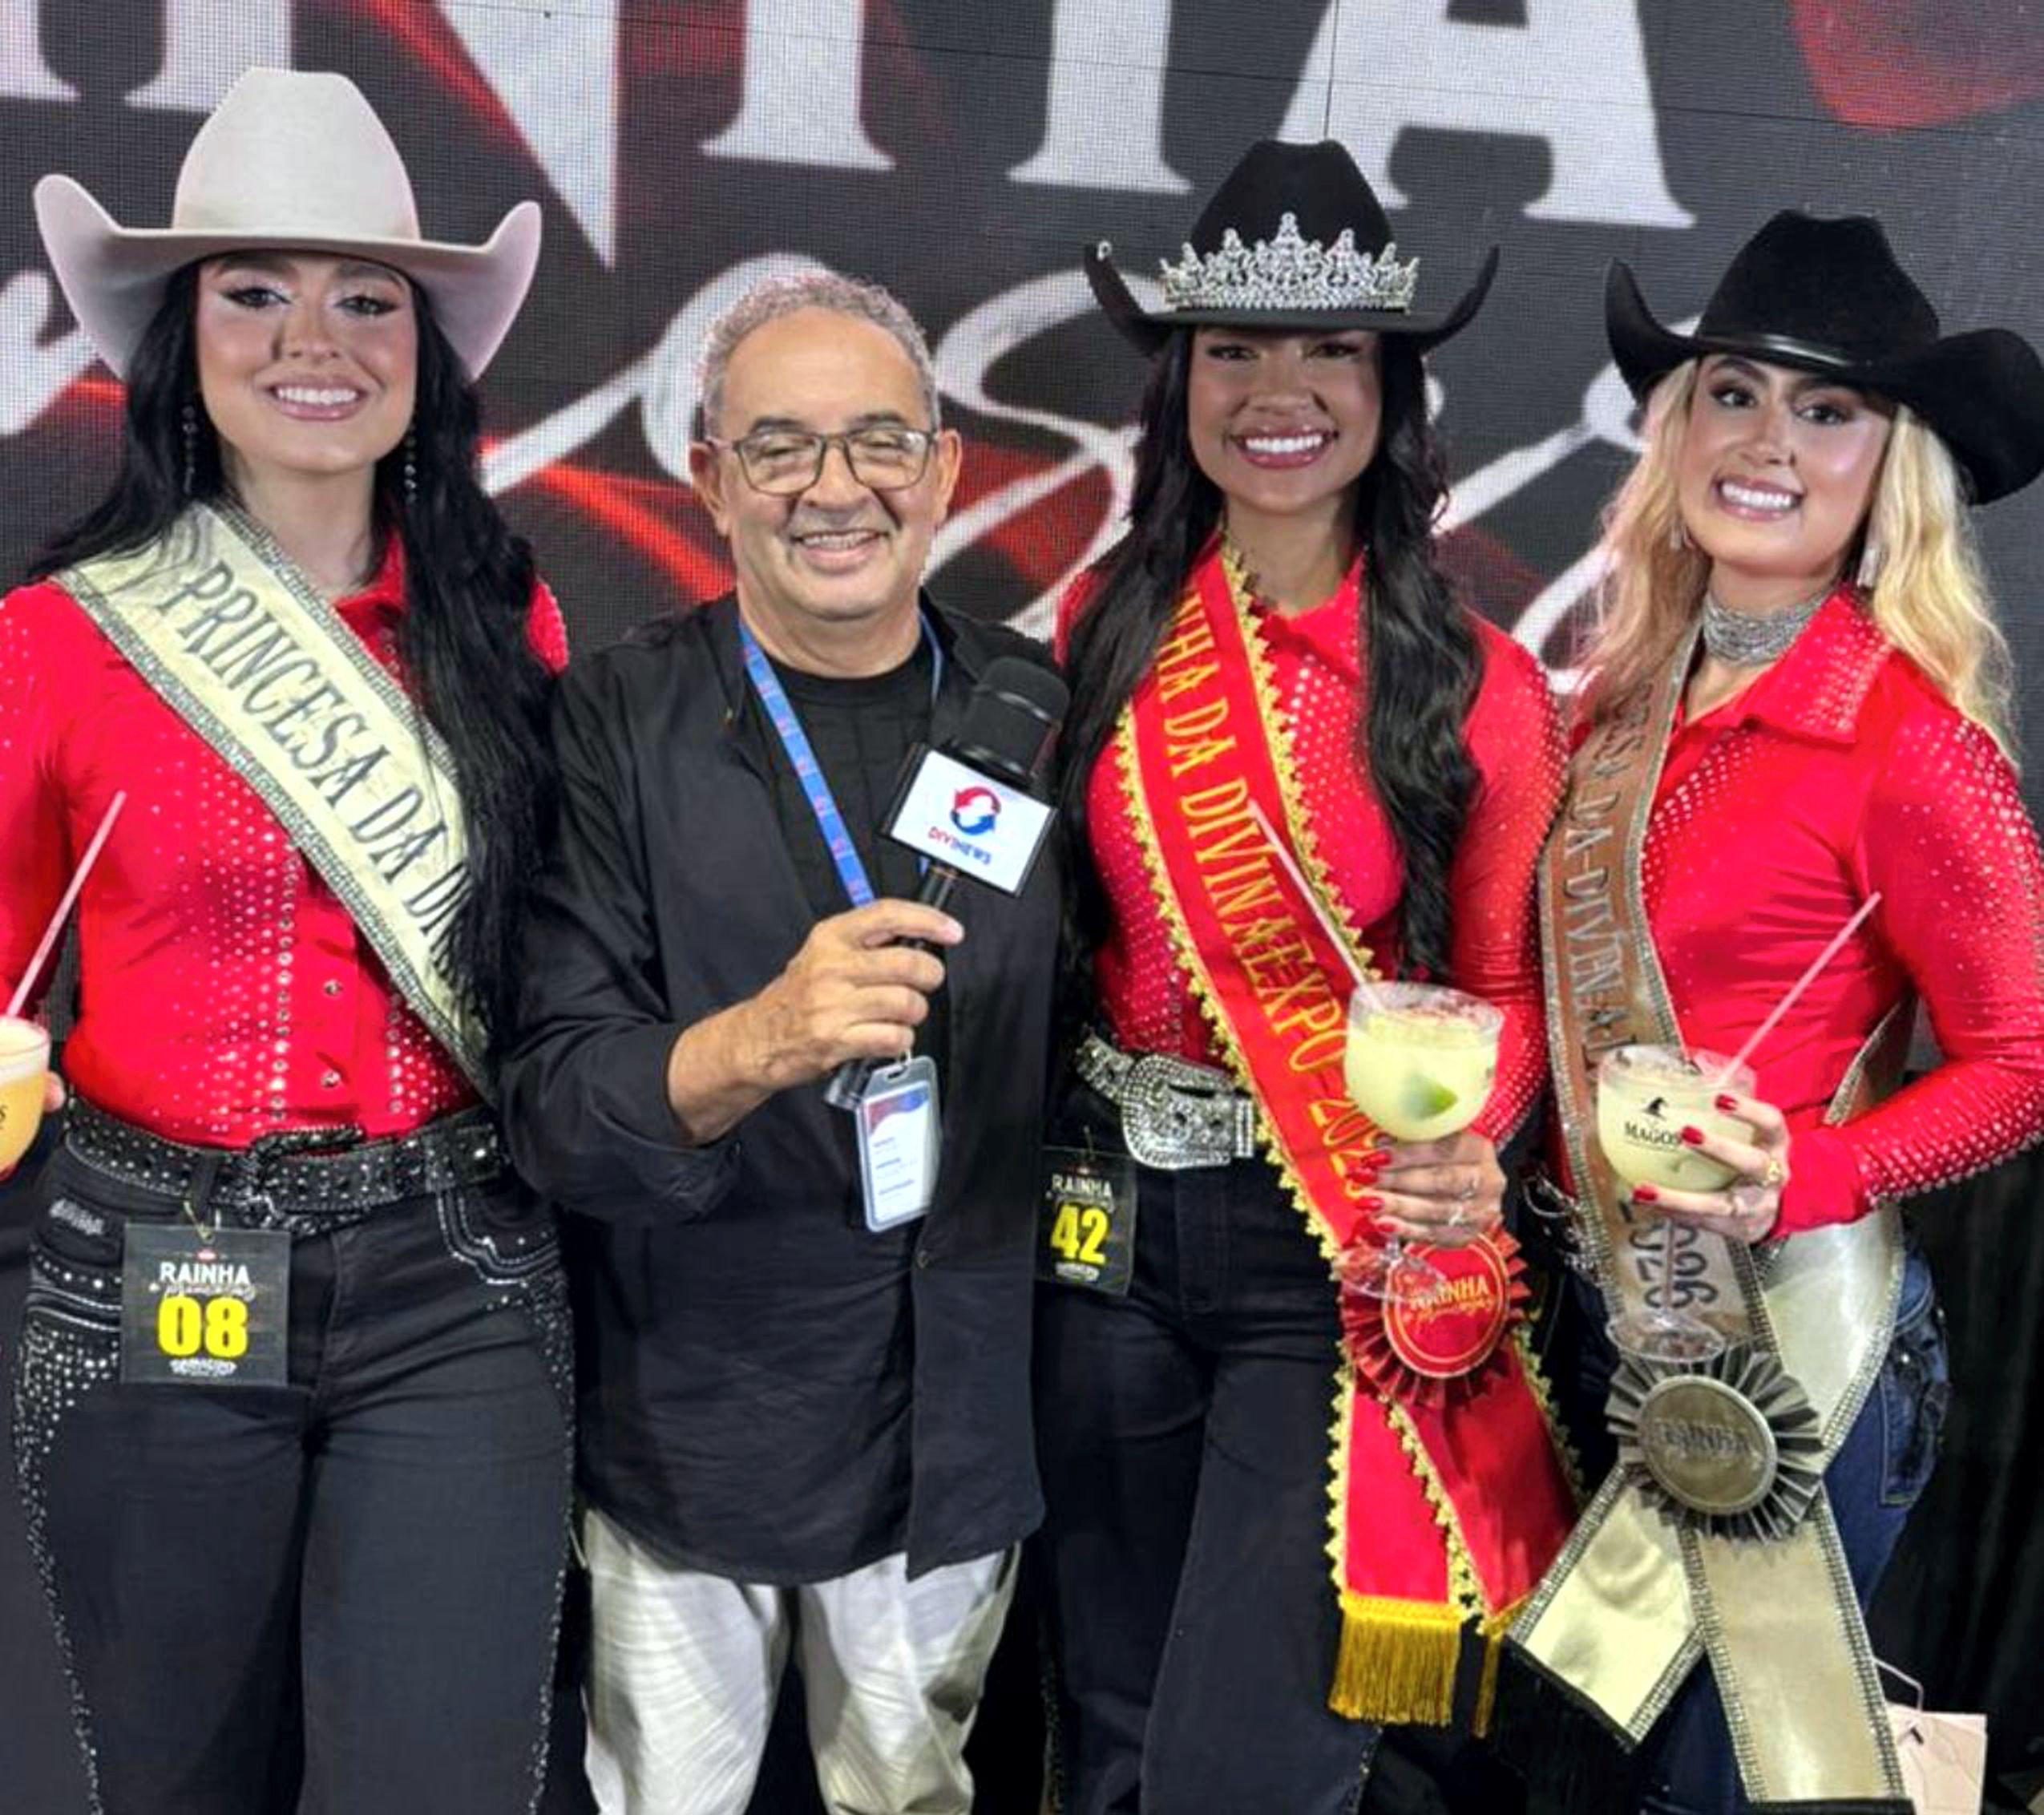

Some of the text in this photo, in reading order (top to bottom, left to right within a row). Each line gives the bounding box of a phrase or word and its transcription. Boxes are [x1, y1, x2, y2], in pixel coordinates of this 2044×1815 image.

[158, 560, 390, 809] PRINCESA
[348, 785, 448, 883] DA
[1164, 696, 1237, 778] DA
[1624, 1122, 1683, 1146] MAGOS
[1051, 1173, 1113, 1199] RAINHA
[1051, 1203, 1109, 1265] 42
[160, 1261, 251, 1284] RAINHA
[157, 1295, 248, 1358] 08
